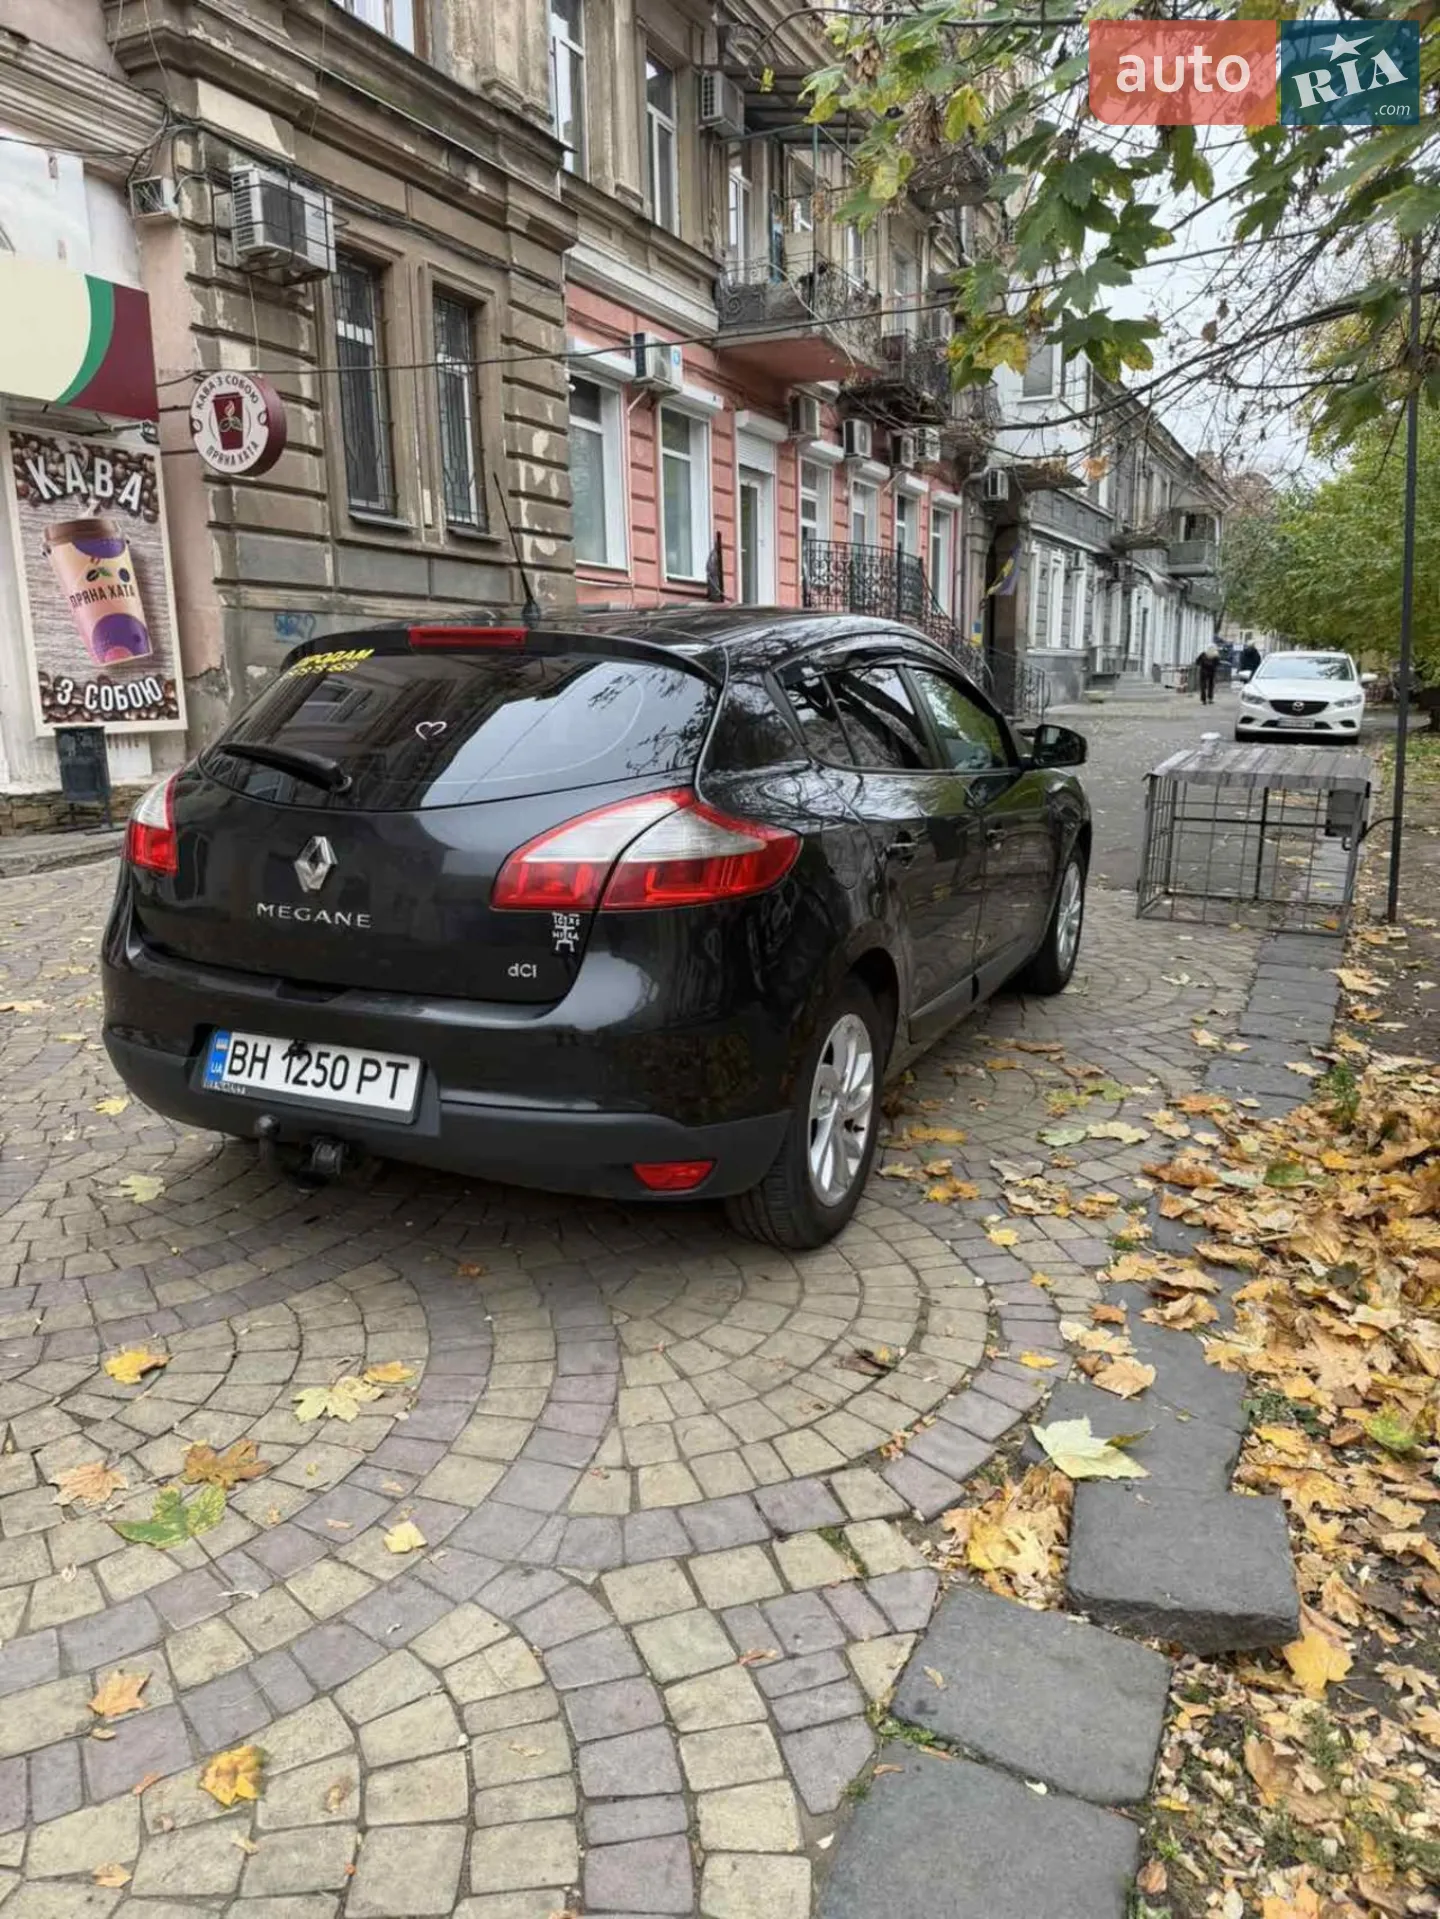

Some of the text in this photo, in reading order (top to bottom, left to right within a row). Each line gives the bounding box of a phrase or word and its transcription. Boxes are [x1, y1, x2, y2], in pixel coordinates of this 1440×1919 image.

[196, 381, 217, 410] КАВА
[225, 375, 259, 404] СОБОЮ
[206, 441, 259, 466] ПРЯНА ХАТА
[25, 453, 143, 511] КАВА
[69, 584, 135, 608] ПРЯНА ХАТА
[57, 677, 163, 711] З СОБОЮ
[257, 902, 371, 929] MEGANE
[227, 1040, 409, 1100] BH 1250 PT
